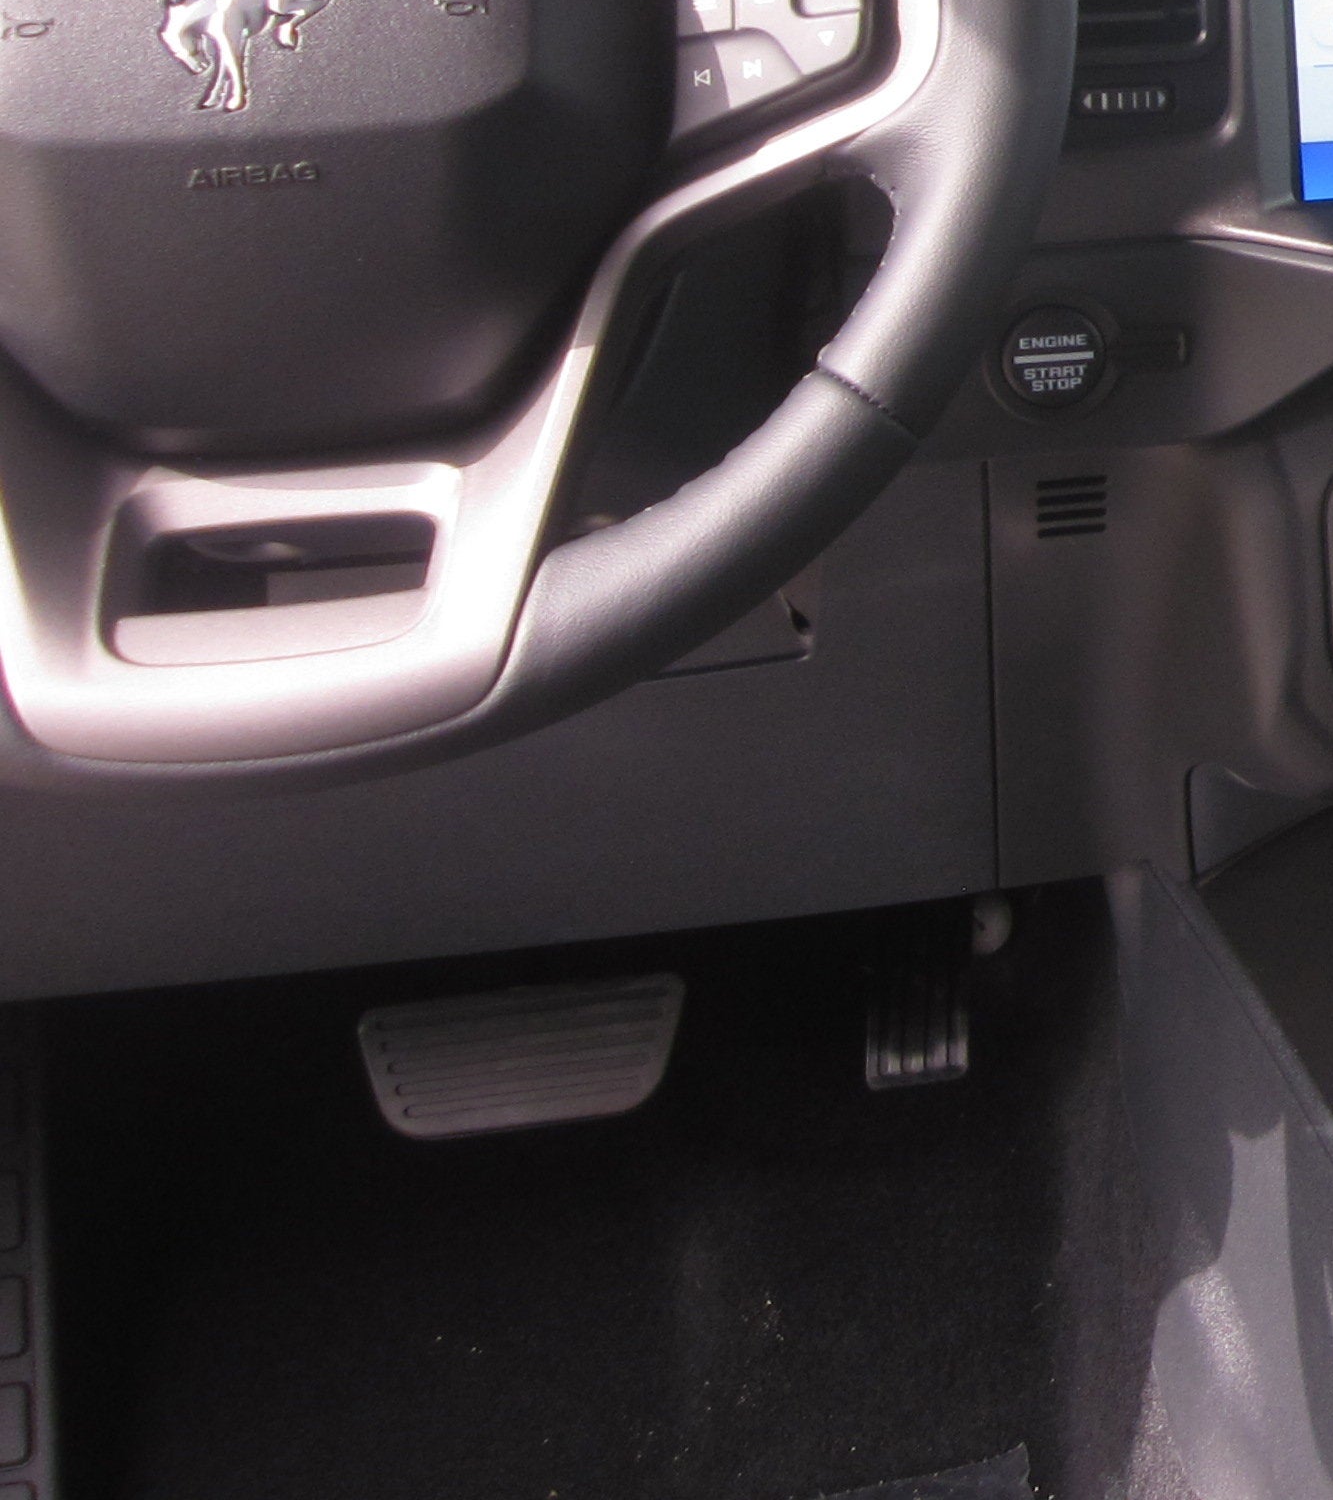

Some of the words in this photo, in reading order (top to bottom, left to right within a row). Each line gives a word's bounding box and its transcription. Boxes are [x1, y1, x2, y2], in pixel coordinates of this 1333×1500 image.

[187, 160, 319, 188] AIRBAG
[1018, 334, 1088, 350] ENGINE
[1023, 364, 1087, 381] START
[1031, 377, 1083, 392] STOP
